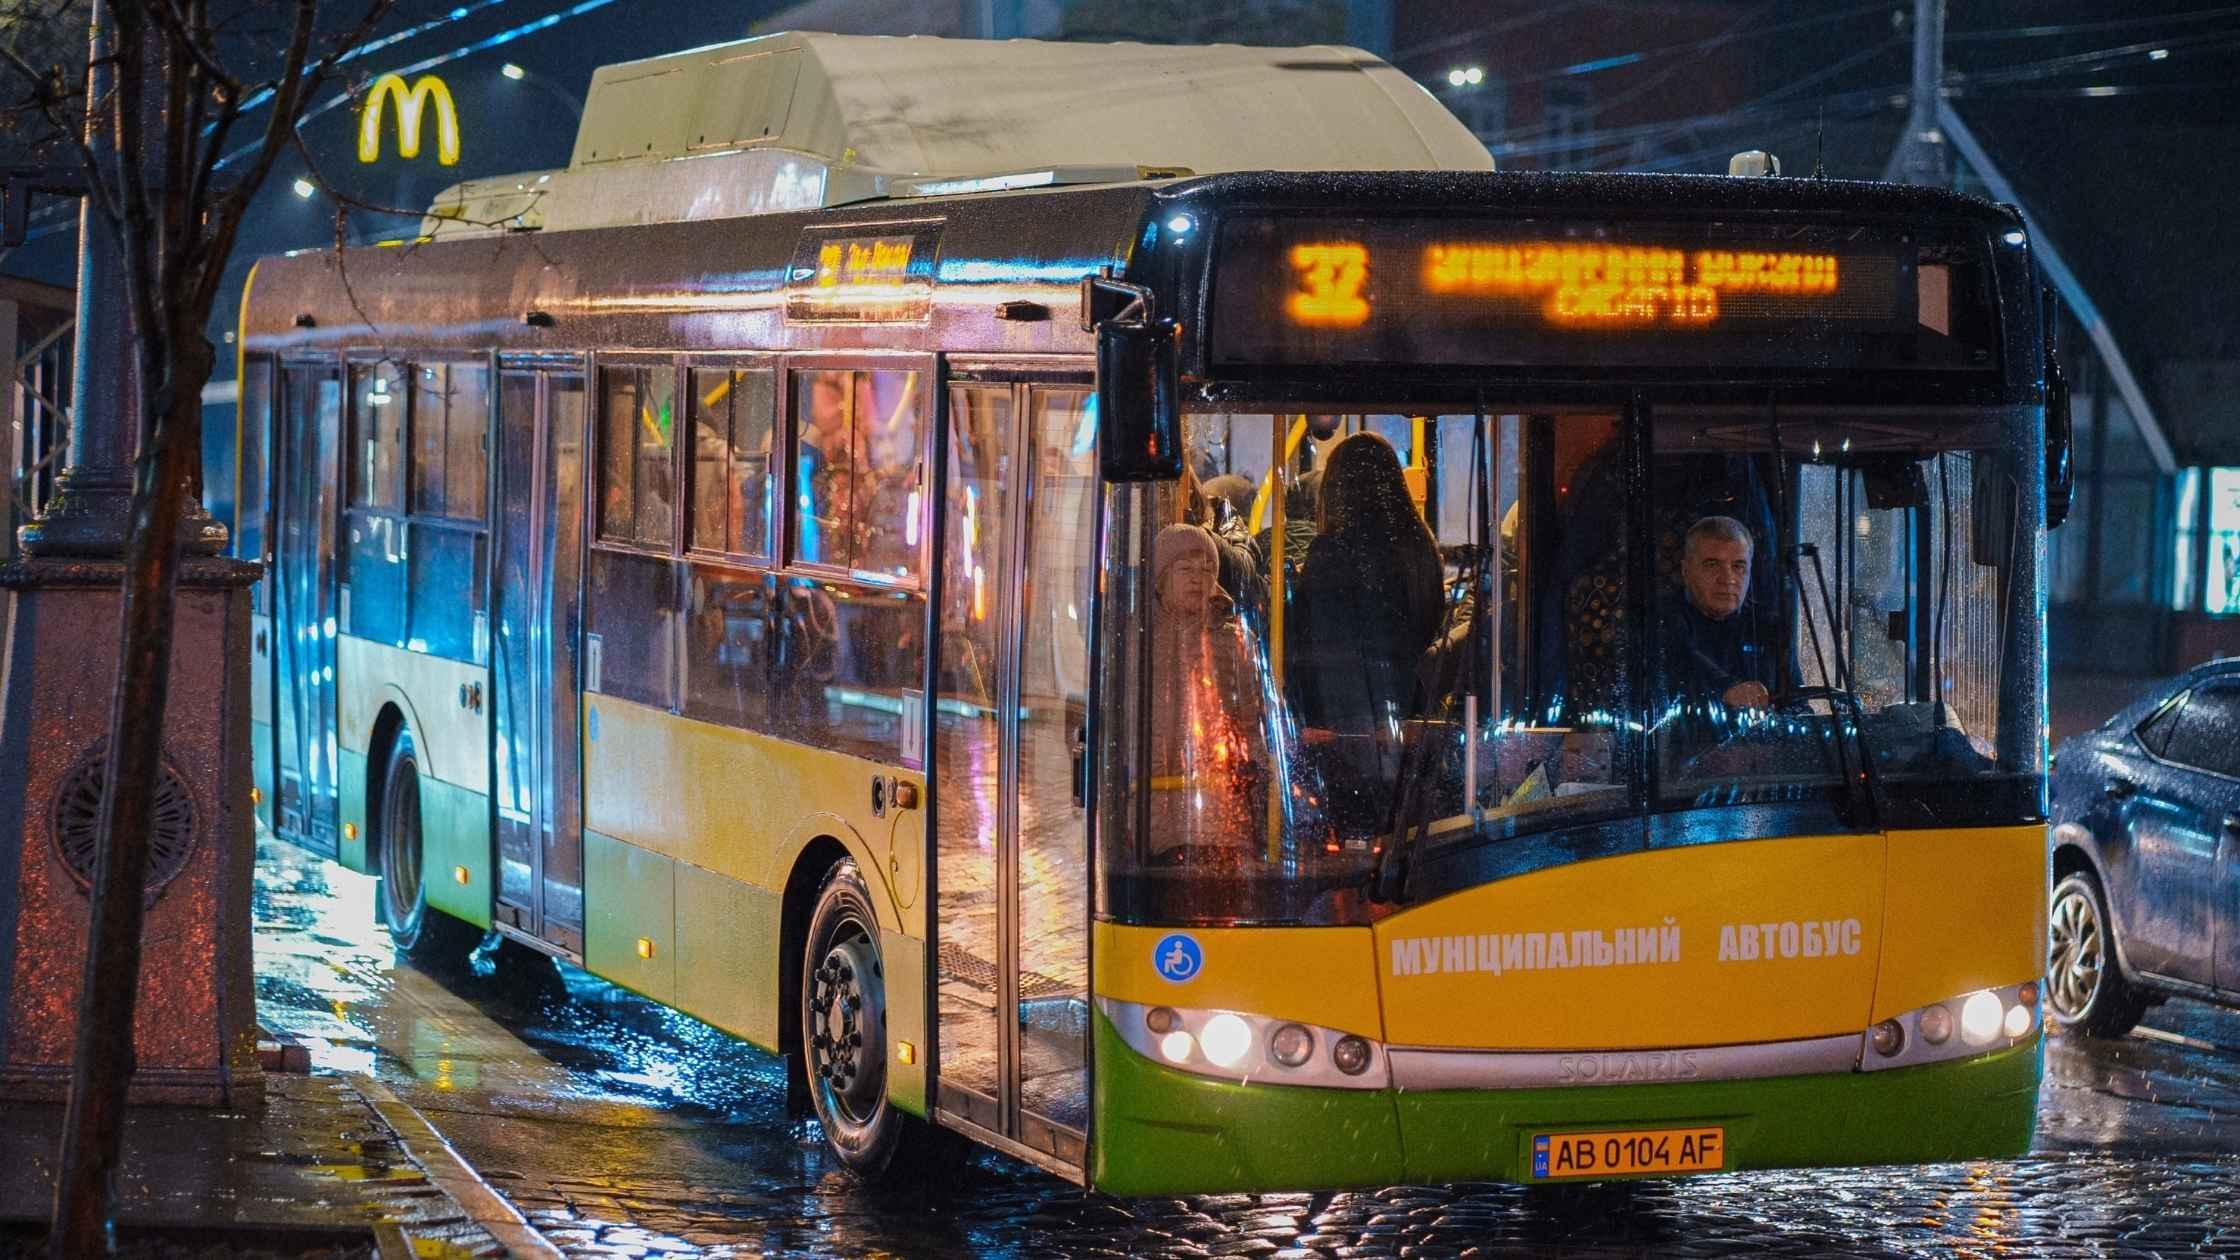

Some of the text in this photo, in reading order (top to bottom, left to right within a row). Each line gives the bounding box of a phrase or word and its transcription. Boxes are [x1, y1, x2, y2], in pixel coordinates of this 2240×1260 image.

[360, 73, 460, 166] M
[1391, 917, 1862, 976] МУНІЦИПАЛЬНИЙ АВТОБУС
[1559, 1051, 1698, 1084] SOLARIS
[1604, 1136, 1670, 1168] 0104
